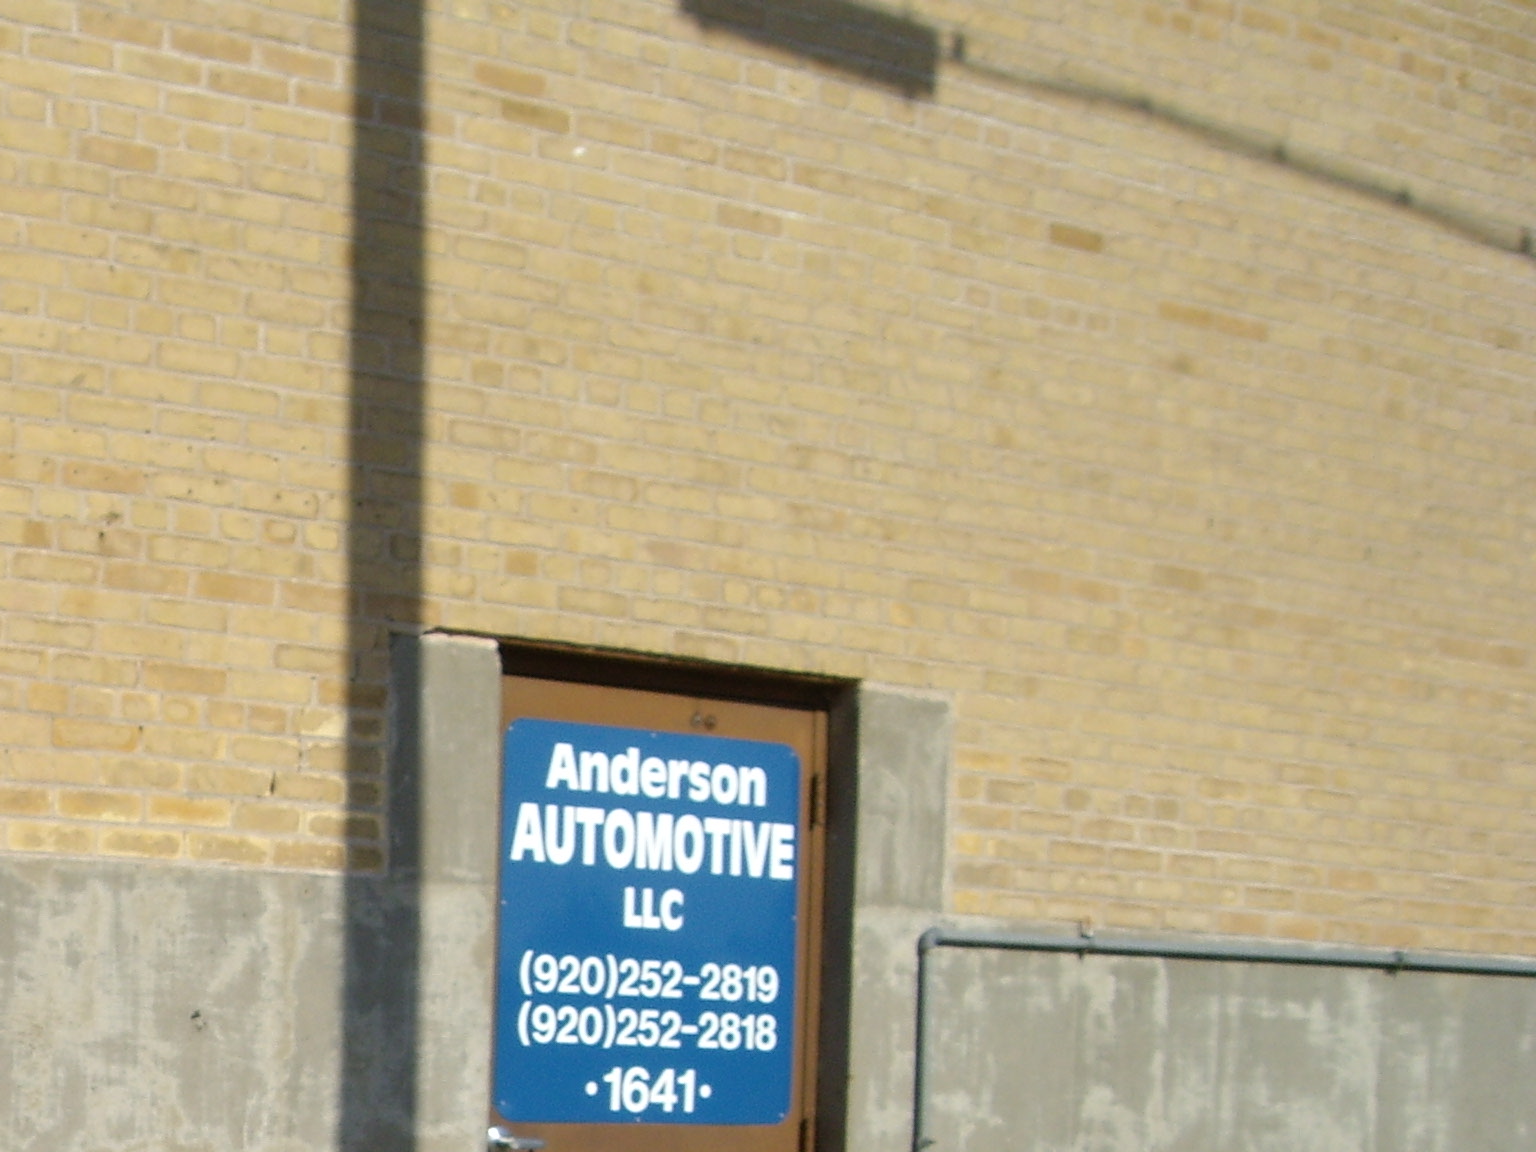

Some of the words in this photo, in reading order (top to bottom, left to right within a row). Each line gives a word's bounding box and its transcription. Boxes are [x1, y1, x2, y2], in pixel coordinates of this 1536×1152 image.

[546, 742, 767, 807] Anderson
[510, 802, 795, 881] AUTOMOTIVE
[622, 886, 685, 931] LLC
[519, 950, 780, 1004] (920)252-2819
[517, 1001, 778, 1052] (920)252-2818
